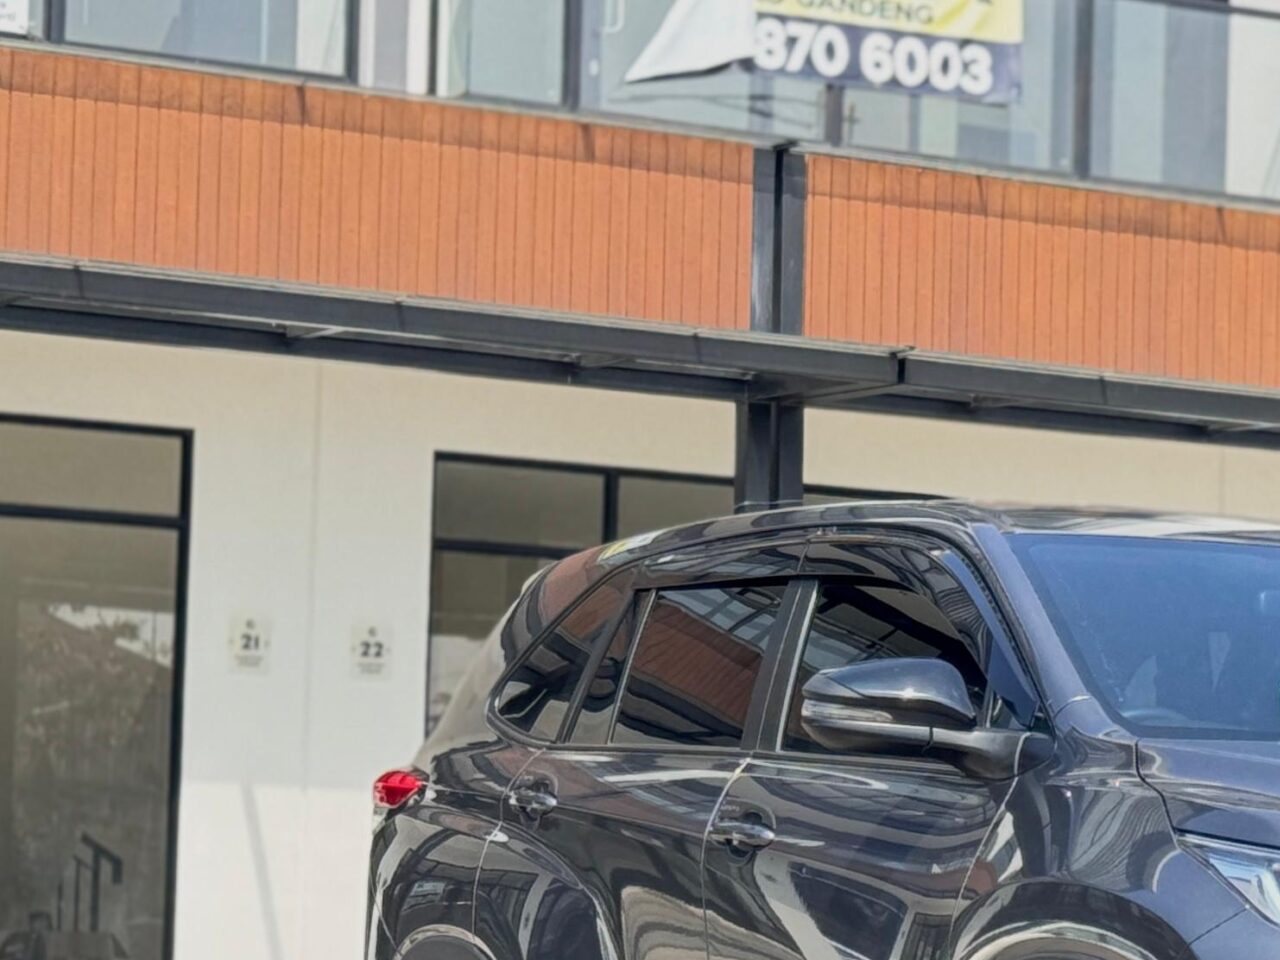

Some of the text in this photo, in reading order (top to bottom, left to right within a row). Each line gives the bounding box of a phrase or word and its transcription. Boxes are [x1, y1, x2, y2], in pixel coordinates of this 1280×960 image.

[753, 16, 994, 96] 870 6003
[241, 633, 260, 650] 21
[360, 640, 384, 658] 22
